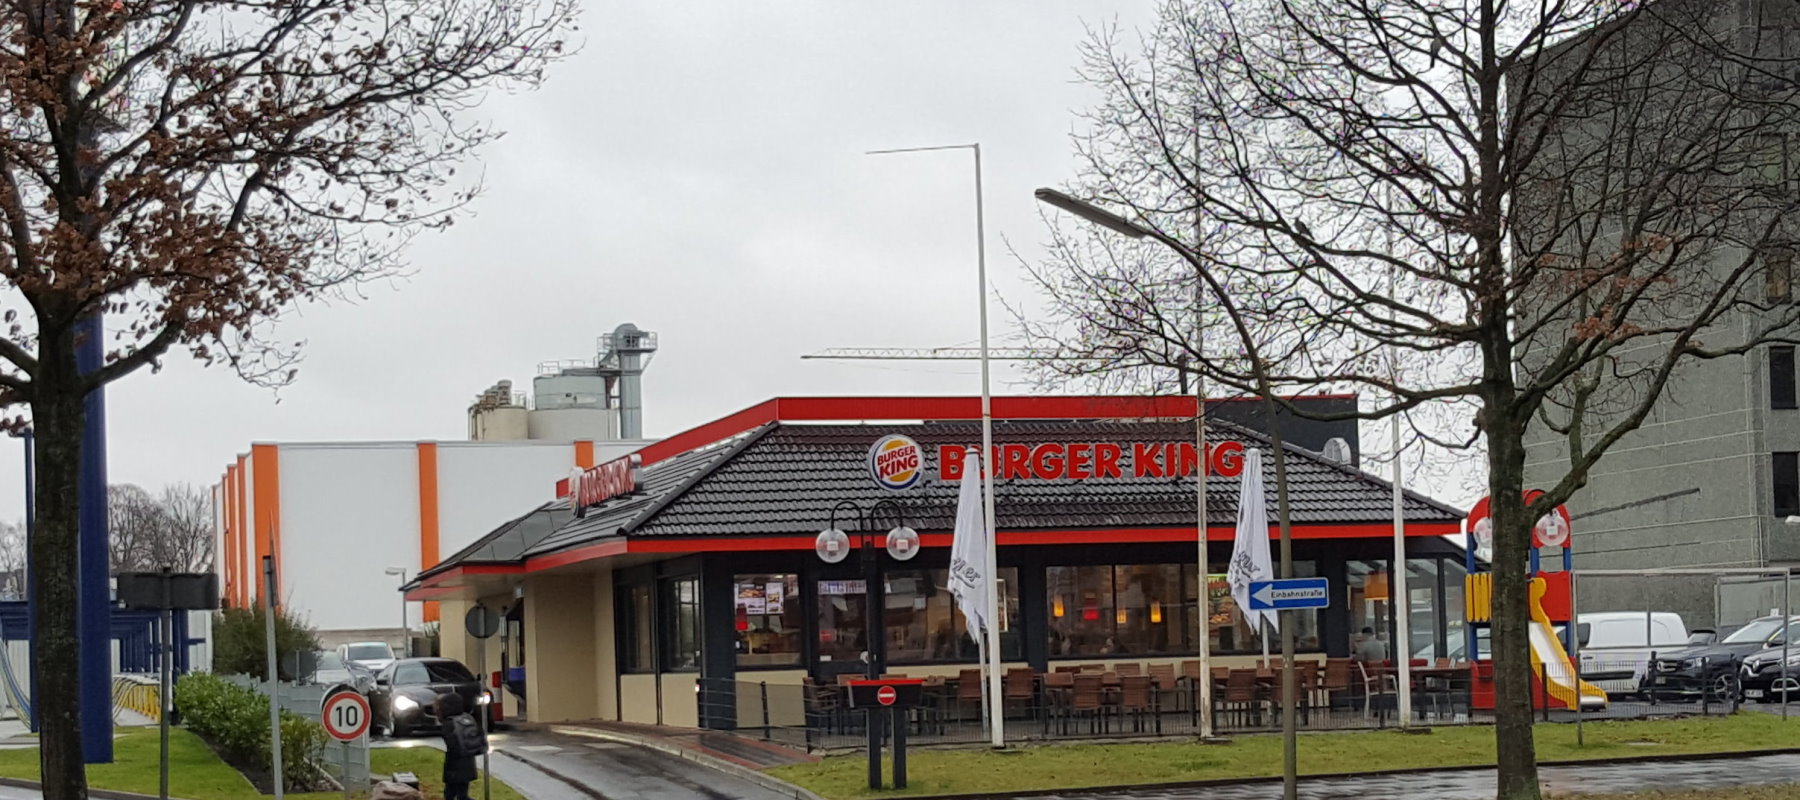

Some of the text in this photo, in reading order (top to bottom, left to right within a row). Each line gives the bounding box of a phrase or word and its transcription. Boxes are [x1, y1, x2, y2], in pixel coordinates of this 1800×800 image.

[877, 445, 916, 466] BURGER
[1134, 440, 1244, 478] KING
[880, 455, 918, 479] KING
[1271, 589, 1323, 598] Einbahnstraße
[336, 706, 358, 727] 10
